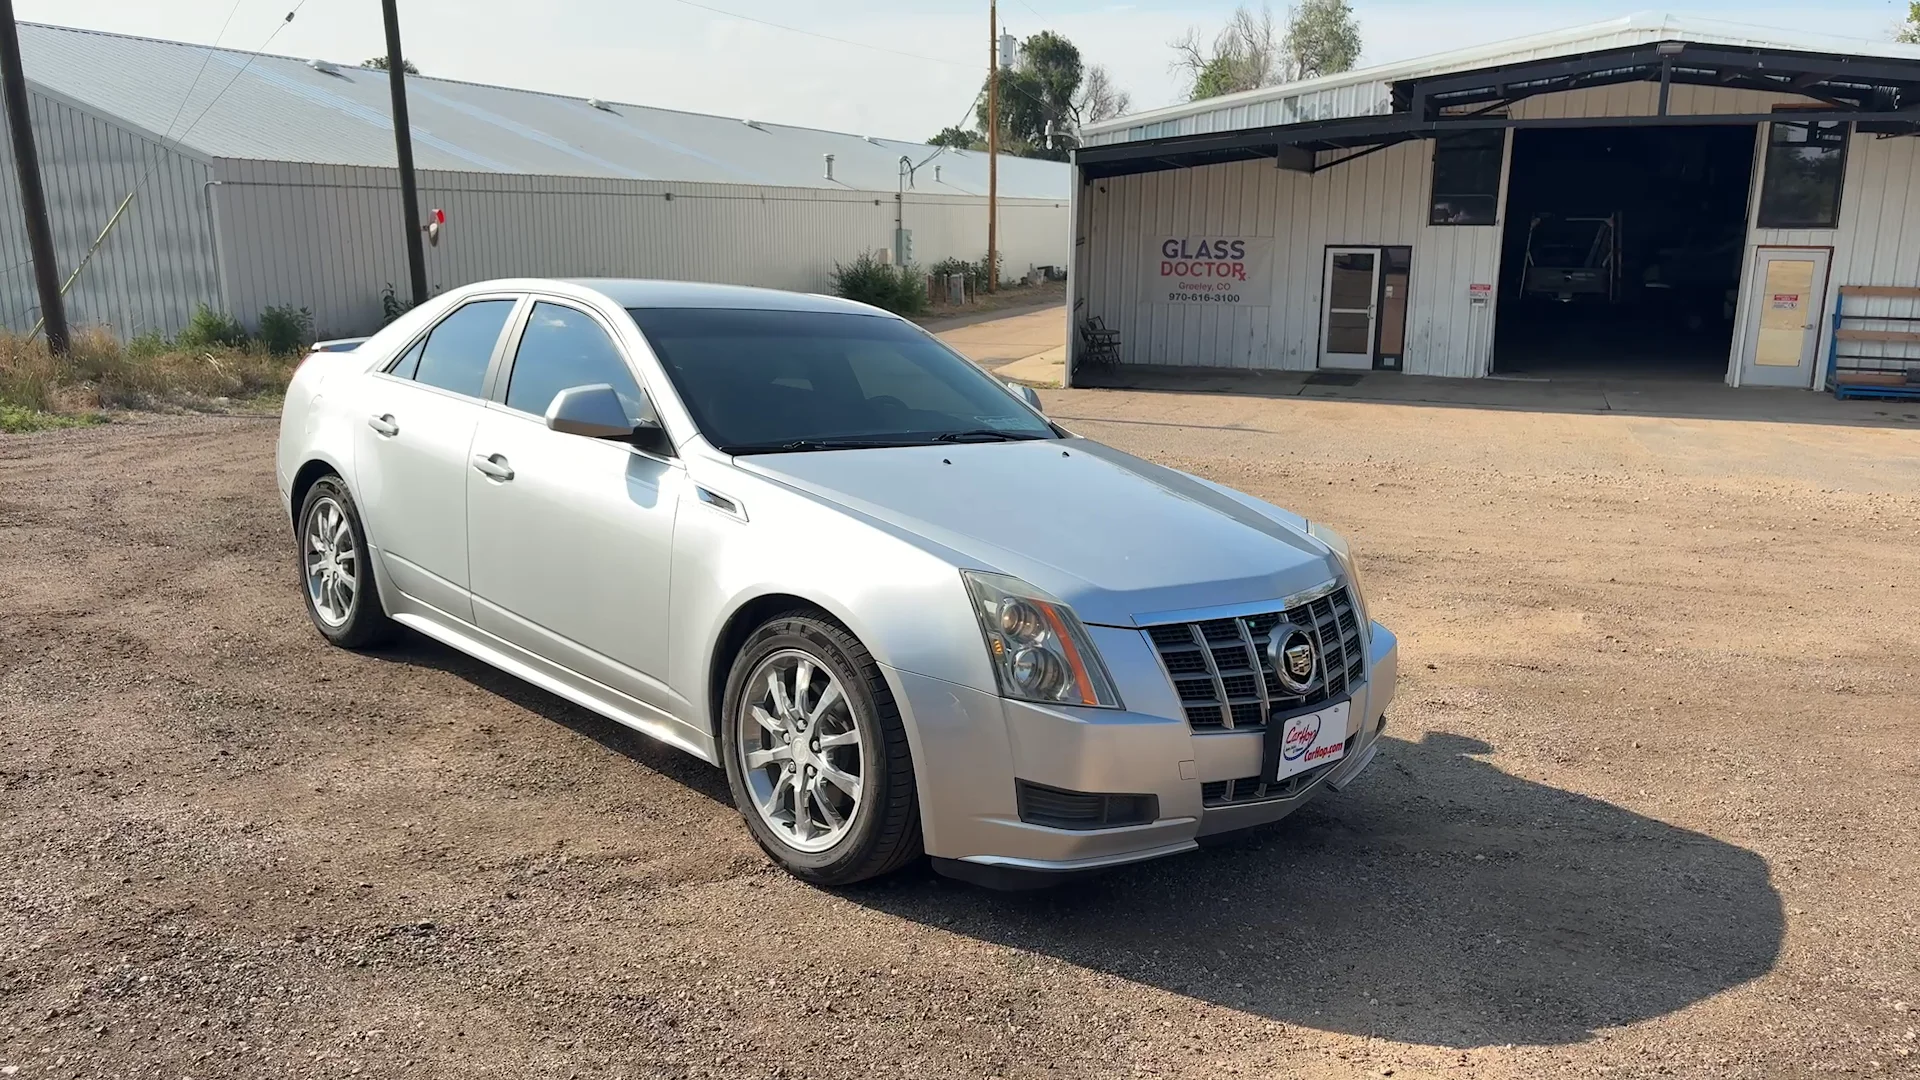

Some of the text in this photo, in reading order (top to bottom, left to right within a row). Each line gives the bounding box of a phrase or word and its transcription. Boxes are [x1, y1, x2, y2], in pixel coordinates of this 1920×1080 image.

[1162, 239, 1245, 260] GLASS
[1178, 281, 1231, 292] Greeley, CO
[1168, 292, 1240, 303] 970-616-3100
[1285, 723, 1317, 745] CarHop
[1304, 742, 1344, 762] CarHop.com
